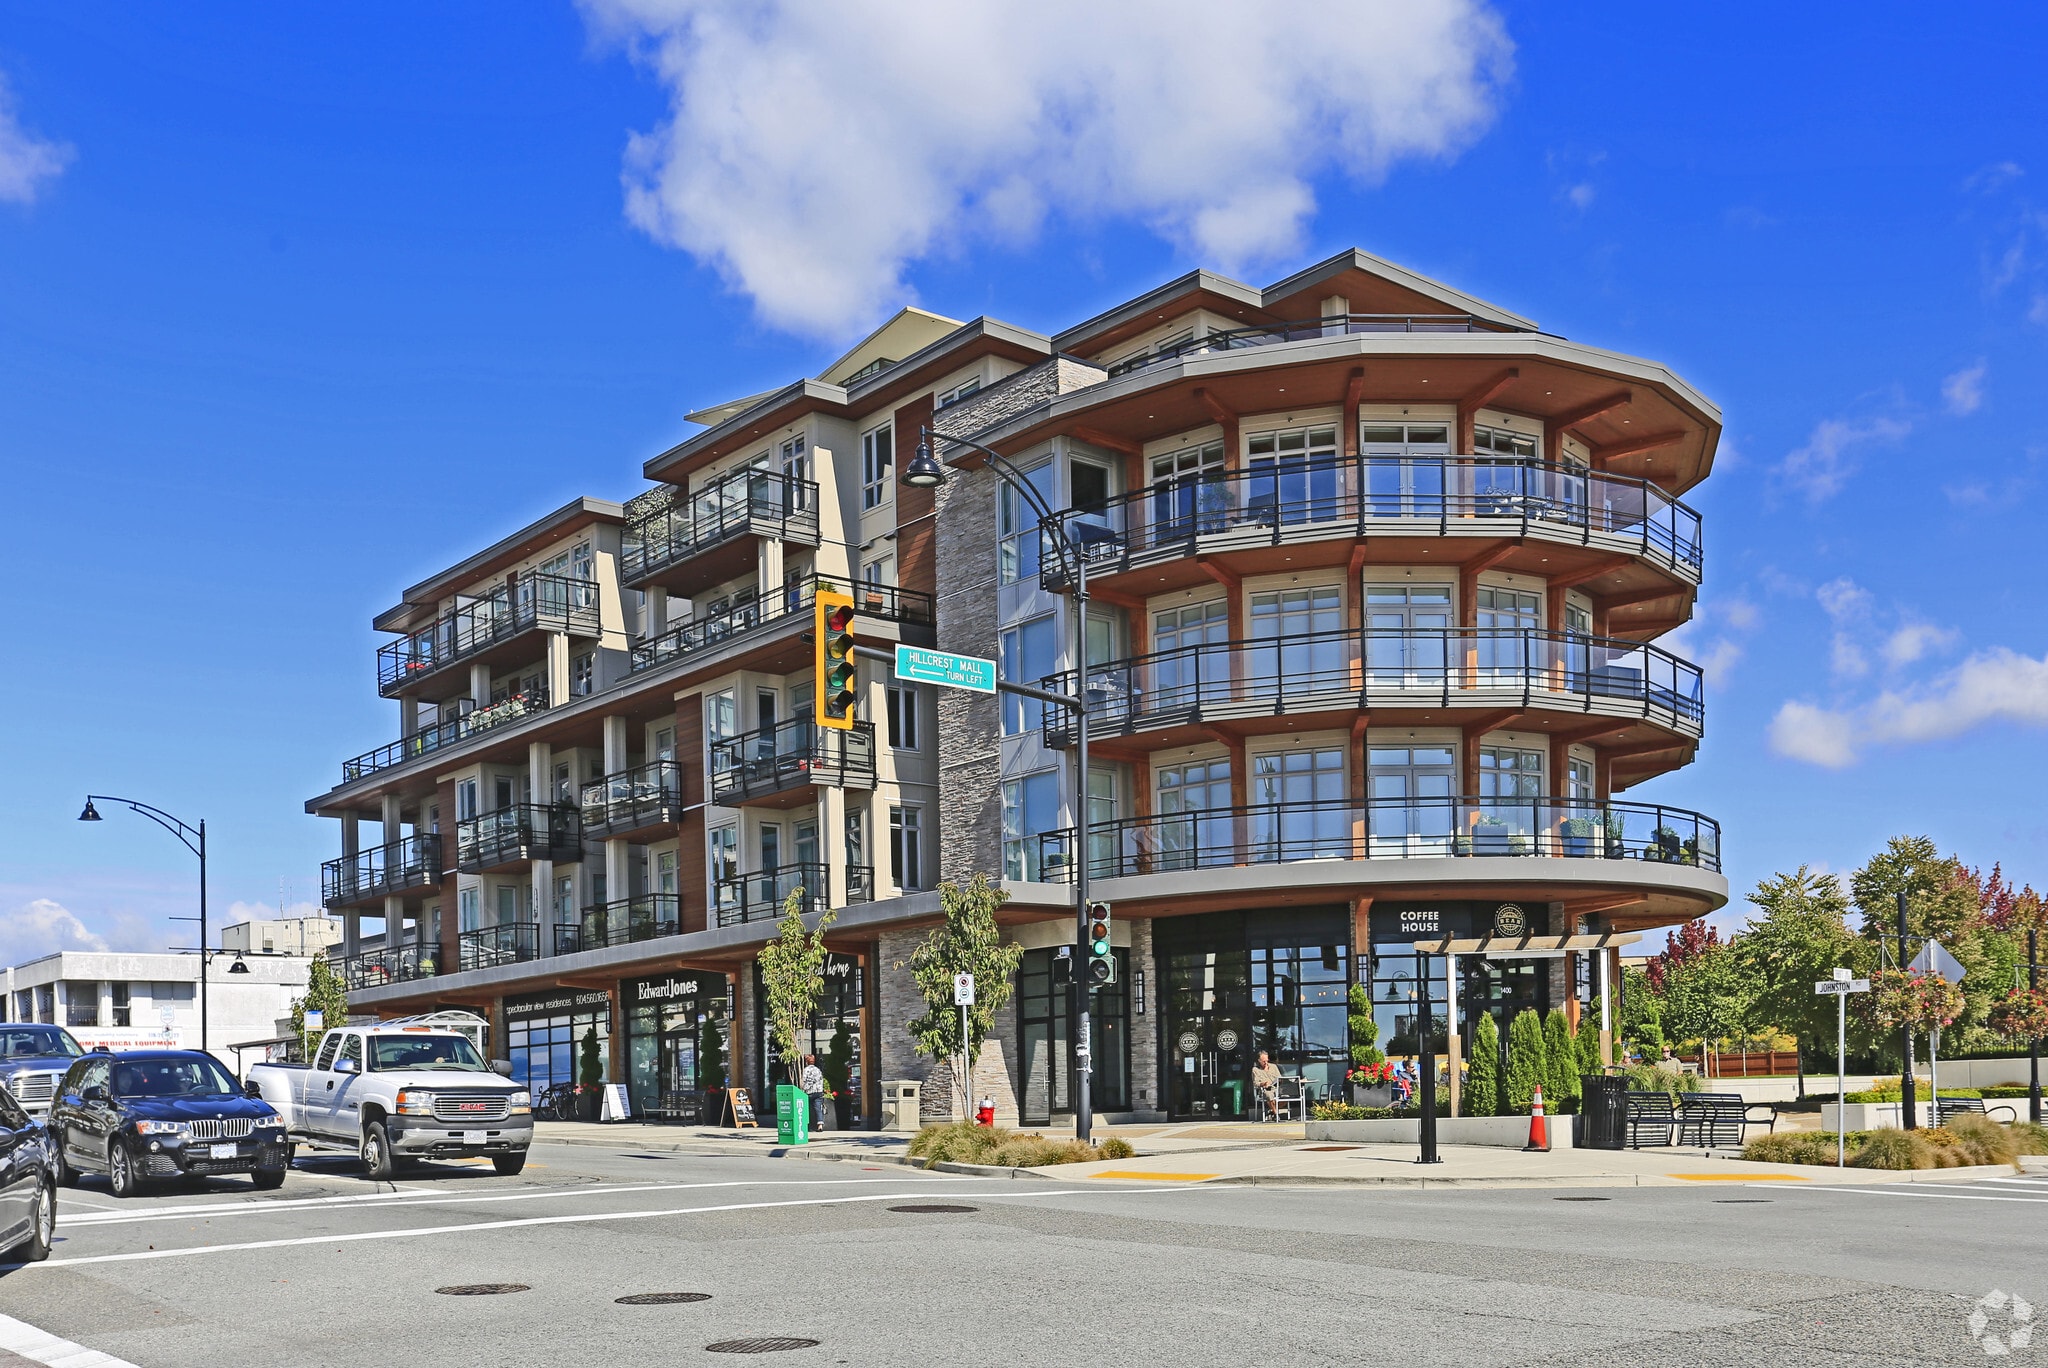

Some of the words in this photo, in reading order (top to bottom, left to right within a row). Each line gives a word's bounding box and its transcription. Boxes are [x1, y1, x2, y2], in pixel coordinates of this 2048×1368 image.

[909, 652, 953, 669] HILLCREST
[960, 661, 983, 674] MALL
[947, 671, 964, 681] TURN
[966, 675, 982, 684] LEFT
[1400, 911, 1439, 921] COFFEE
[1402, 922, 1439, 932] HOUSE
[827, 953, 850, 977] home
[1820, 982, 1850, 992] JOHNSTON
[506, 1002, 533, 1016] spectacular
[534, 1002, 545, 1011] view
[546, 998, 572, 1009] residences
